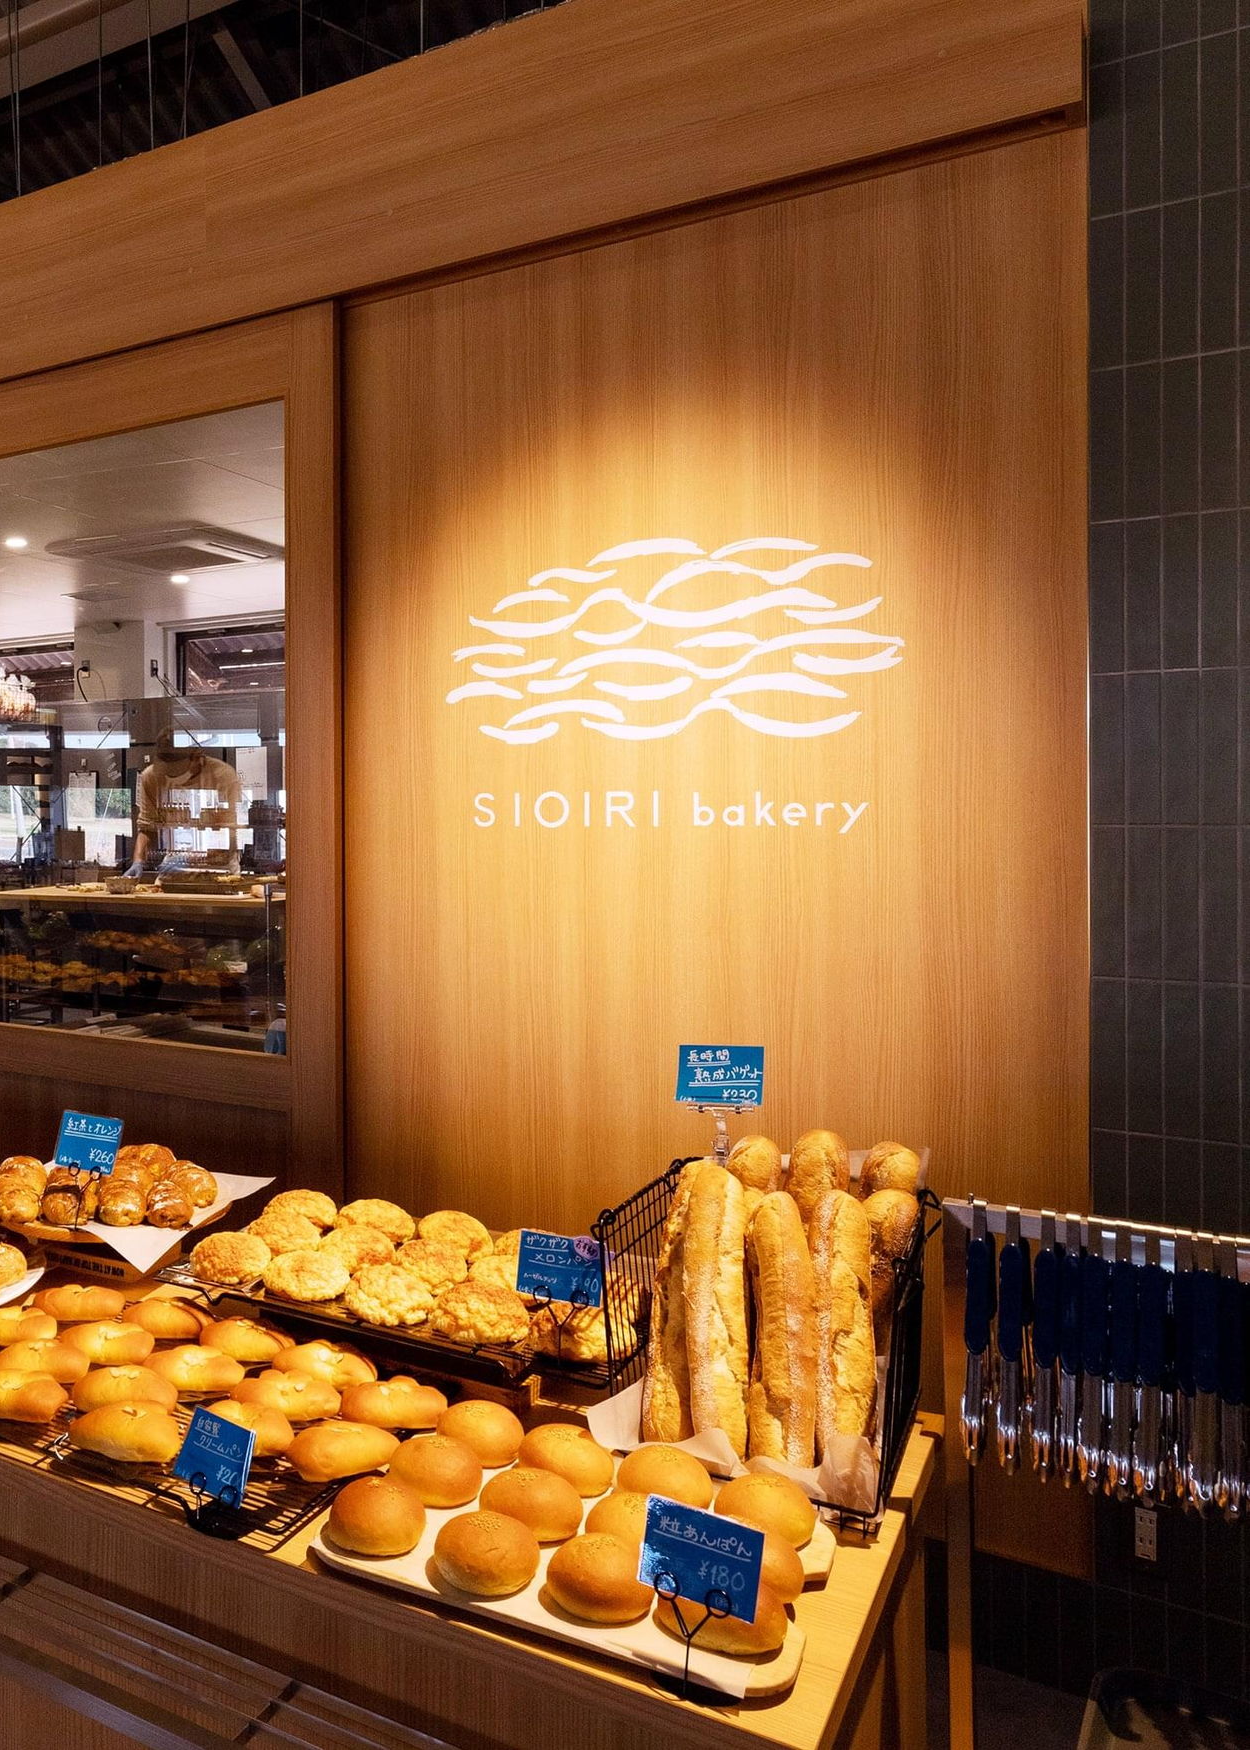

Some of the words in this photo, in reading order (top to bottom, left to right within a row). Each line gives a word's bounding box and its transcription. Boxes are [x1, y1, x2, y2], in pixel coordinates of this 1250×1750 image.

[473, 789, 660, 829] SIOIRI
[692, 790, 870, 835] bakery
[687, 1048, 730, 1062] 長時間
[693, 1064, 763, 1083] 熟成バゲット
[722, 1088, 758, 1101] ¥230
[67, 1117, 122, 1136] 紅茶とオレンジ
[89, 1147, 115, 1165] ¥260
[526, 1235, 569, 1249] ザクザク
[535, 1253, 593, 1267] メロンパン
[199, 1434, 243, 1459] クリームパン
[659, 1515, 753, 1557] 粒あんぱん
[697, 1559, 746, 1592] ¥180
